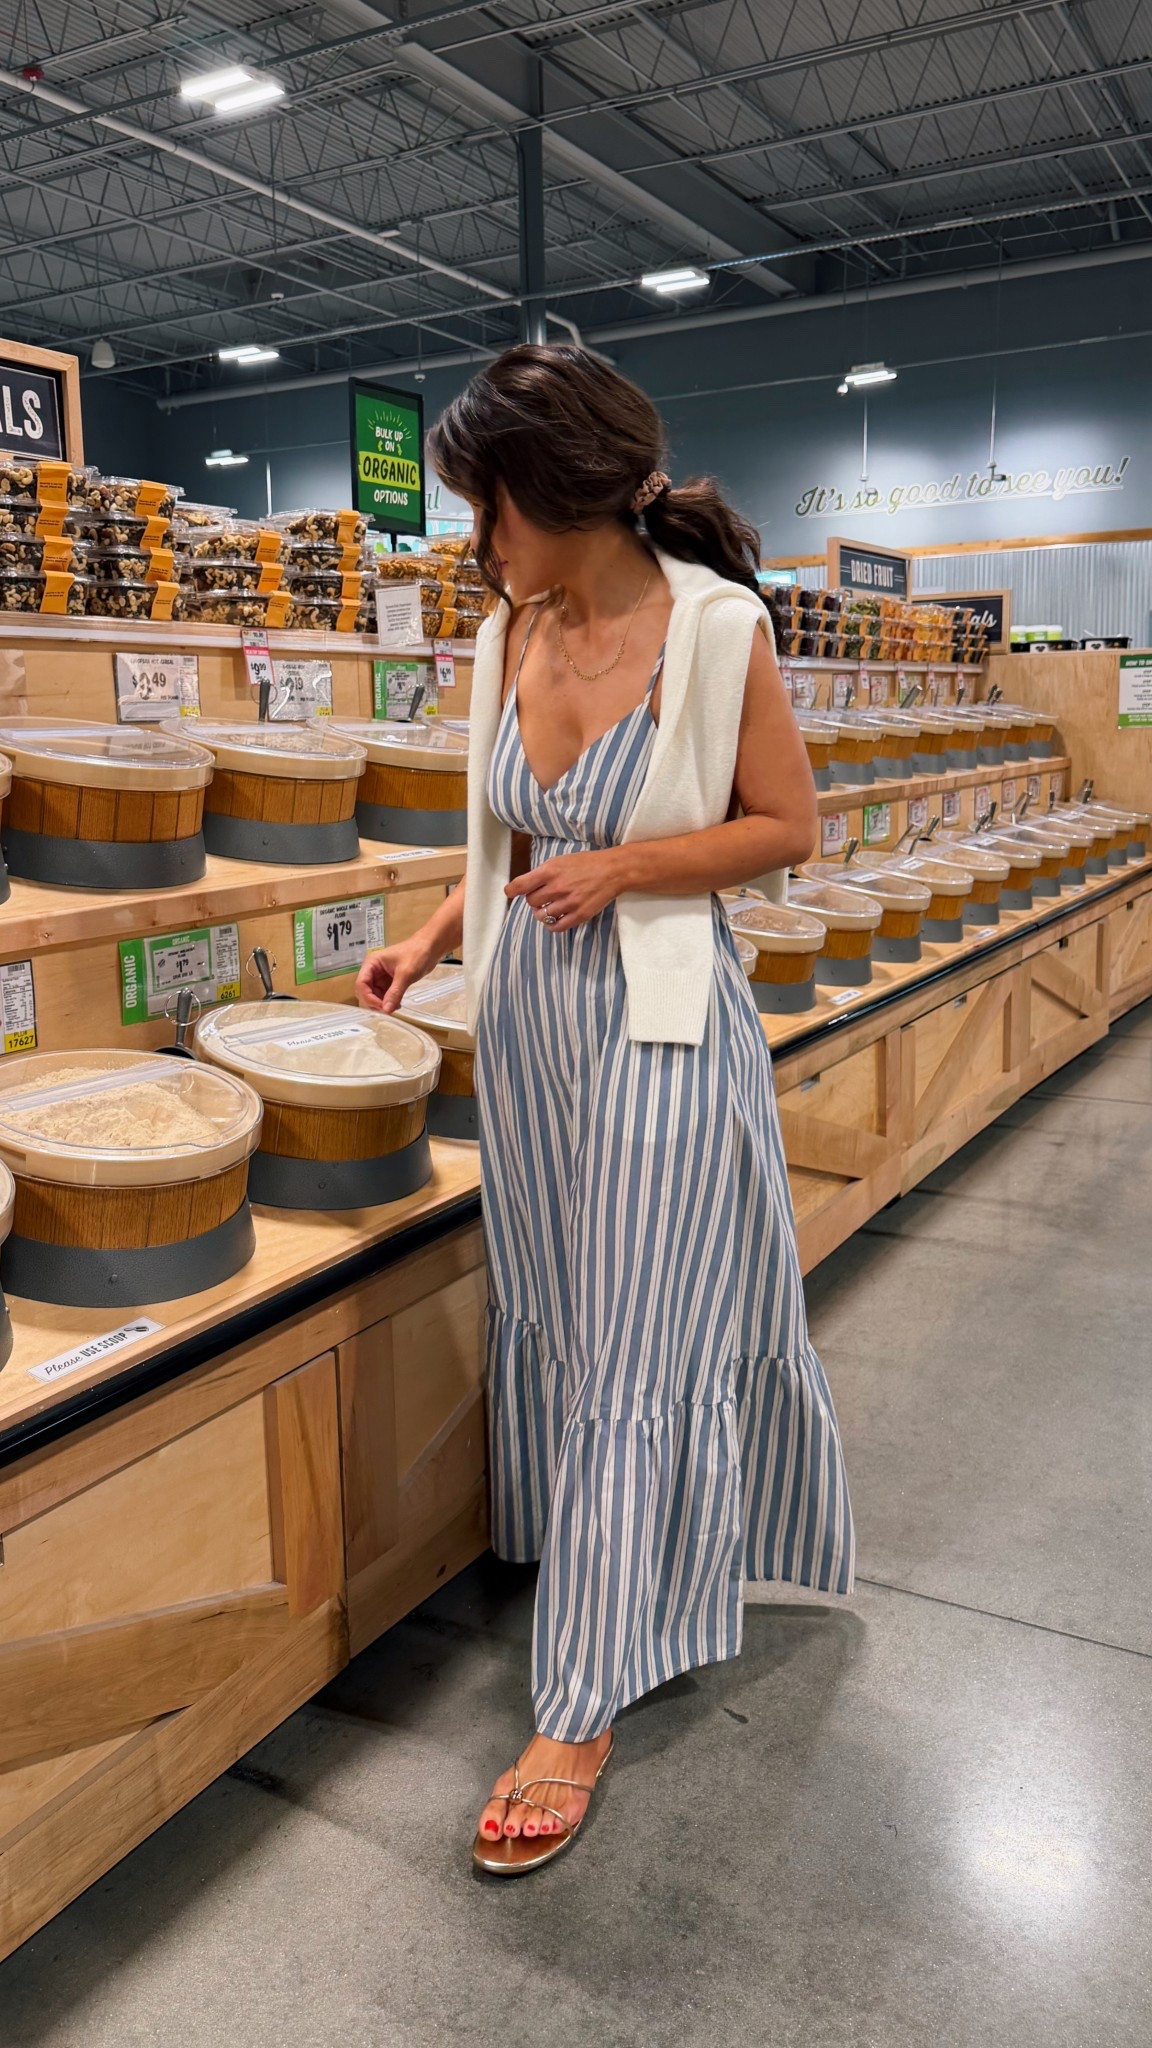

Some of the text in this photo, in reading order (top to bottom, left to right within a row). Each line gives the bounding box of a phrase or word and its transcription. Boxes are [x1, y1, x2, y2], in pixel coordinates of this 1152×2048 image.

[375, 426, 404, 442] BULK UP
[384, 441, 395, 453] ON
[363, 456, 417, 486] ORGANIC
[373, 489, 408, 506] OPTIONS
[795, 486, 845, 517] It's
[888, 474, 960, 515] good
[966, 473, 993, 498] to
[1053, 457, 1129, 499] you!
[851, 559, 894, 588] DRIED FRUIT
[296, 921, 306, 969] ORGANIC
[124, 955, 137, 1008] ORGANIC
[220, 990, 236, 1000] 6261
[8, 1035, 34, 1048] 17627
[44, 1331, 129, 1376] Please USE SCOOP
